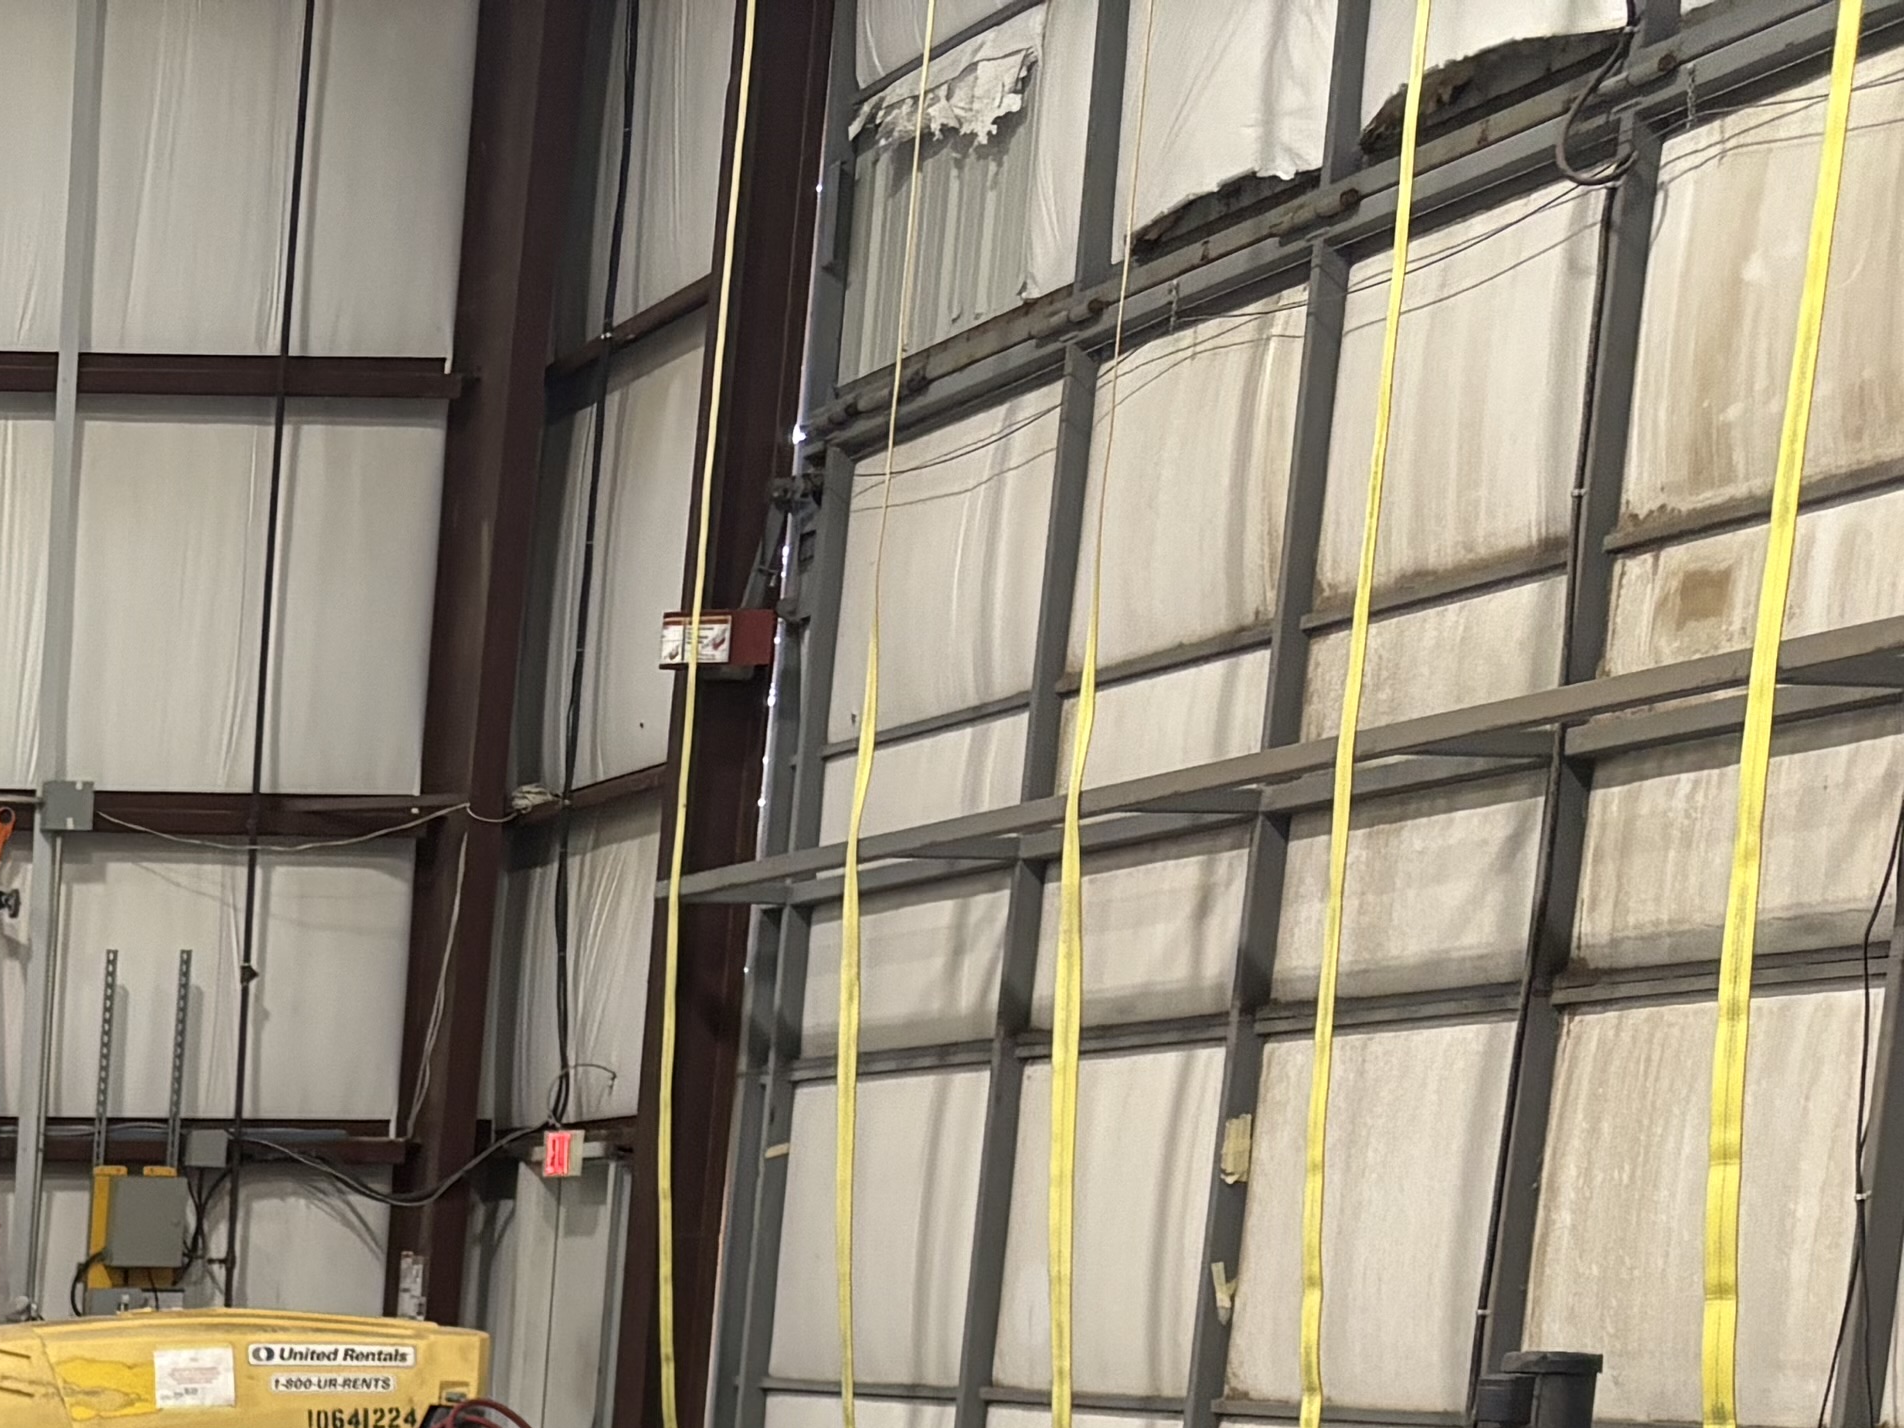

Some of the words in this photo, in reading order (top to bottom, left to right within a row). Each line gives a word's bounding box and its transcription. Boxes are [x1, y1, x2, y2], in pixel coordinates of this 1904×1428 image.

[279, 1348, 338, 1362] United
[343, 1349, 408, 1363] Rentals
[274, 1376, 391, 1390] 1-800-UR-RENTS
